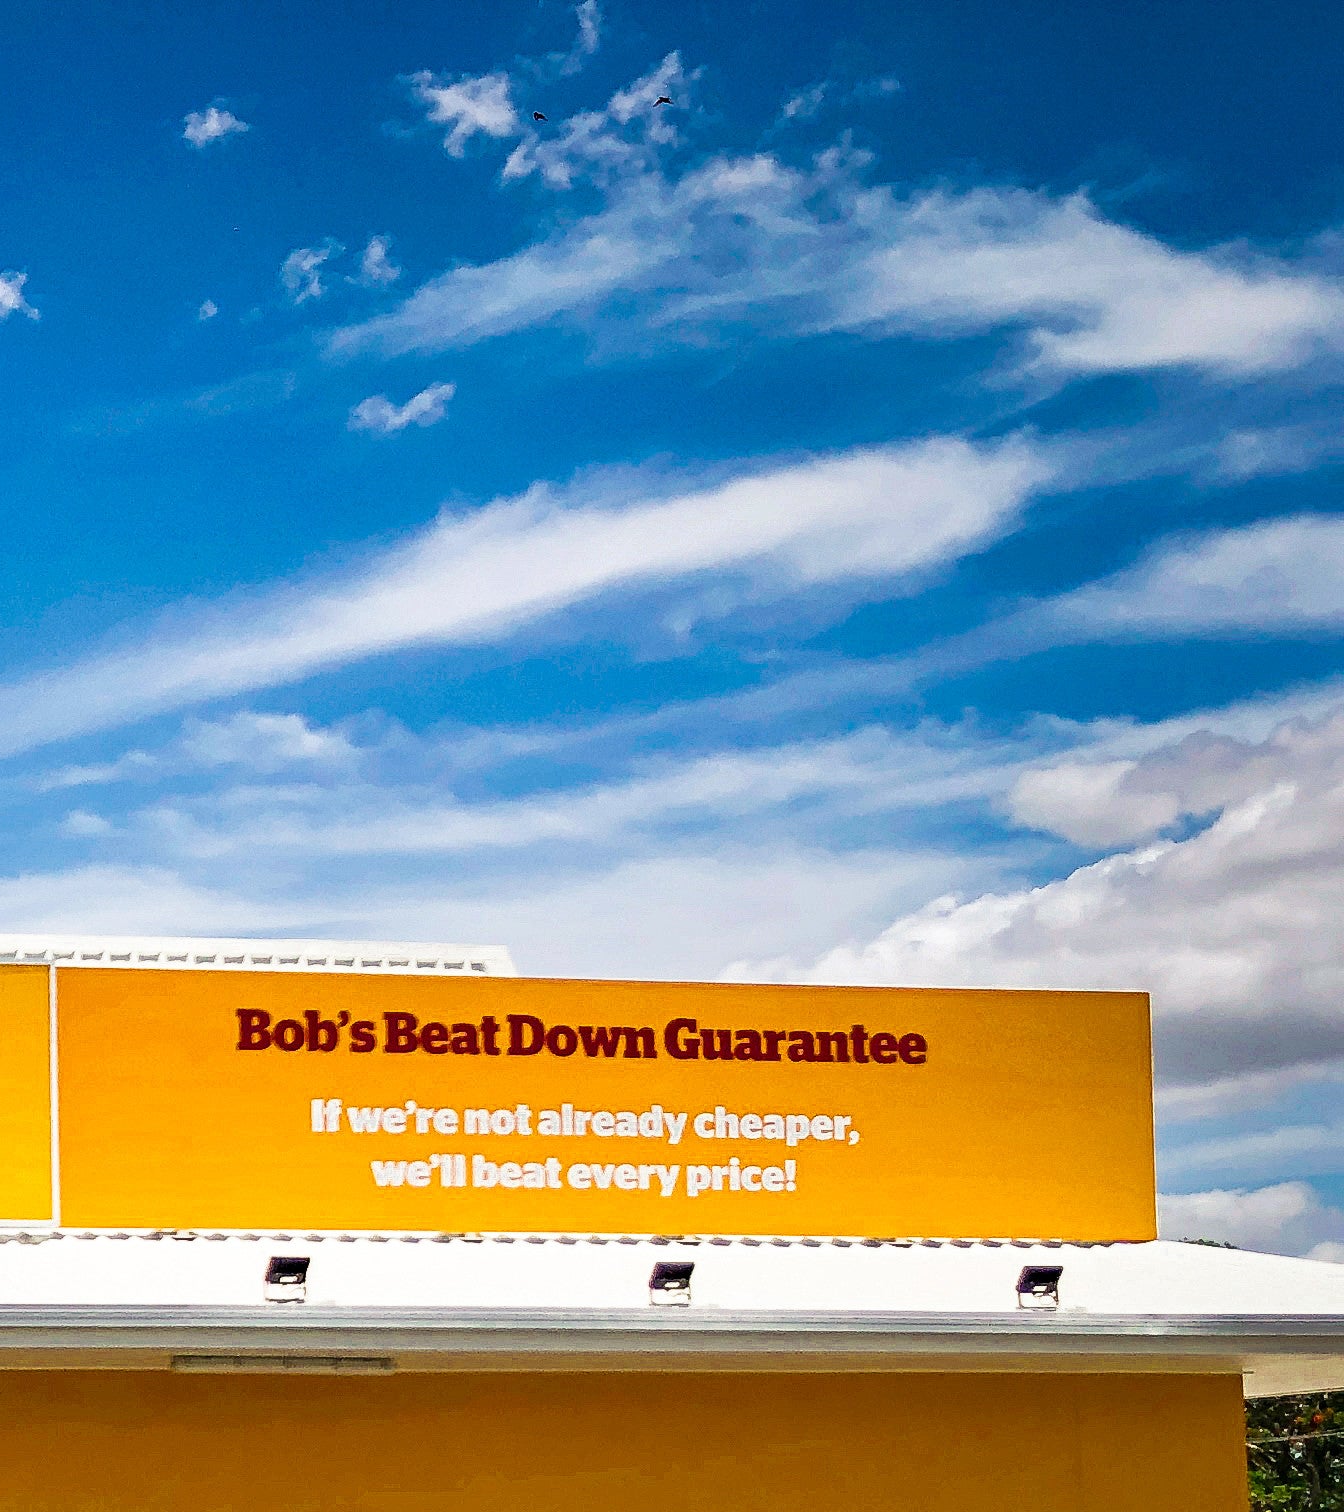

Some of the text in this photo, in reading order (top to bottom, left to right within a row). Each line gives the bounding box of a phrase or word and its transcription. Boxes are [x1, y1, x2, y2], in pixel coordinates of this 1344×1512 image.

[236, 1008, 929, 1065] Bob's Beat Down Guarantee
[310, 1098, 861, 1147] If we're not already cheaper,
[370, 1153, 797, 1197] we'll beat every price!
